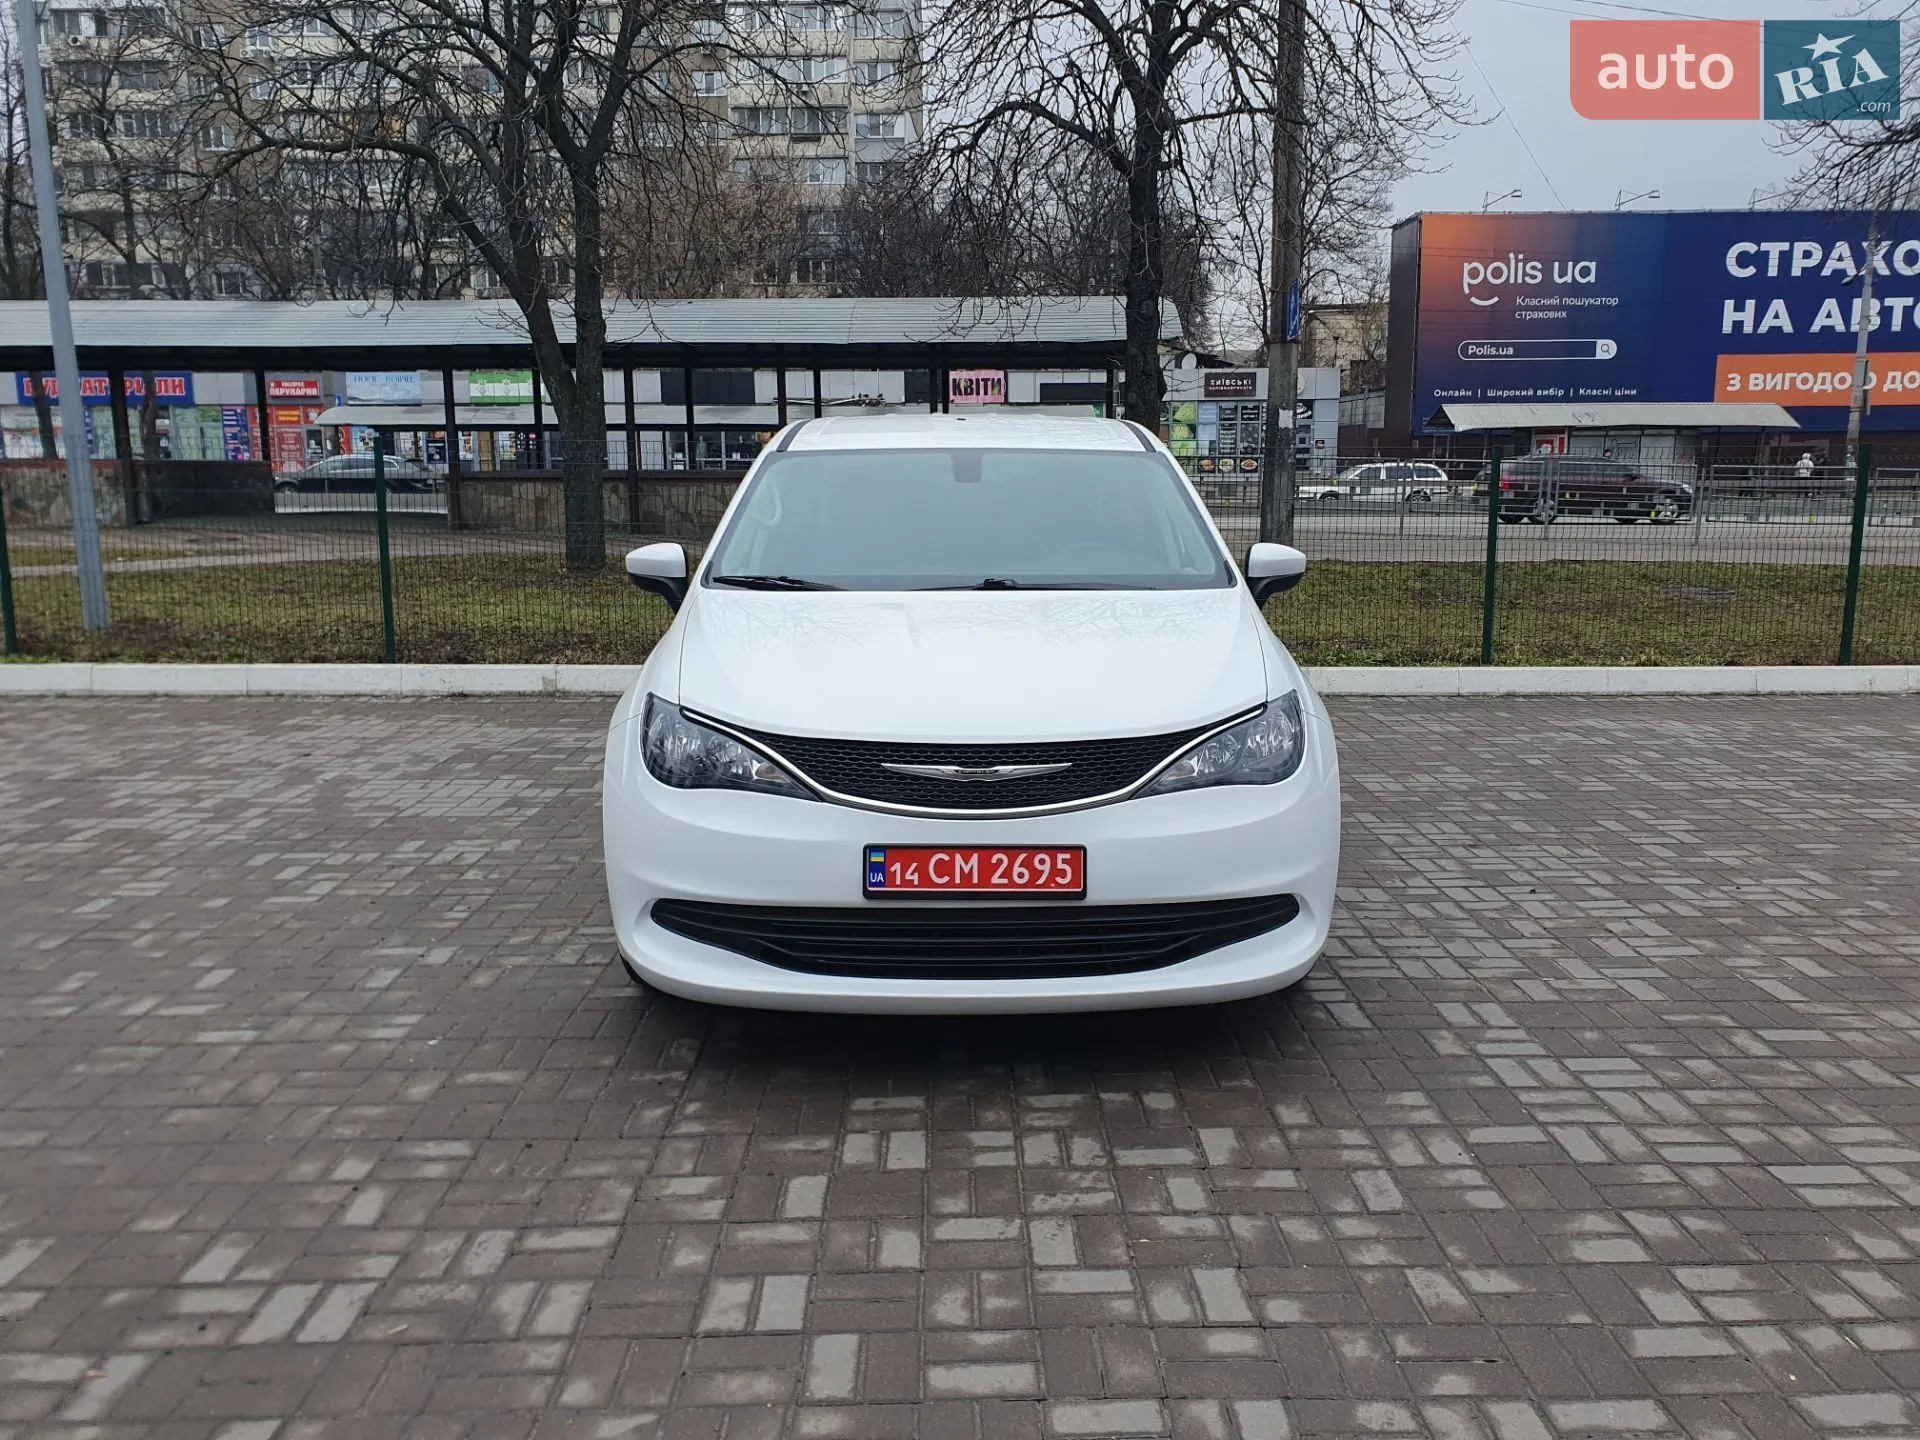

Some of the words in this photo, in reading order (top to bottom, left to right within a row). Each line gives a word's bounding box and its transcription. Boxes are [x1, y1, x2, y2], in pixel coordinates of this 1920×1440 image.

[1463, 252, 1543, 293] polis
[1553, 261, 1596, 284] ua
[1516, 295, 1560, 307] Класний
[1562, 295, 1619, 307] пошукатор
[1515, 309, 1567, 321] страхових
[1721, 298, 1794, 335] НА
[1809, 297, 1920, 334] АВТ
[1468, 345, 1514, 356] Polis.ua
[953, 378, 1001, 396] КВІТИ
[1210, 378, 1252, 386] КИЇВСЬКІ
[269, 387, 318, 396] ПЕРУКАРНЯ
[1434, 388, 1472, 397] Онлайн
[1487, 386, 1533, 398] Широкий
[1536, 387, 1564, 397] вибір
[1579, 386, 1612, 397] Класні
[1613, 387, 1637, 398] ціни
[870, 873, 884, 883] UA
[889, 862, 919, 886] 14
[928, 853, 979, 885] CM
[990, 853, 1073, 885] 2695
